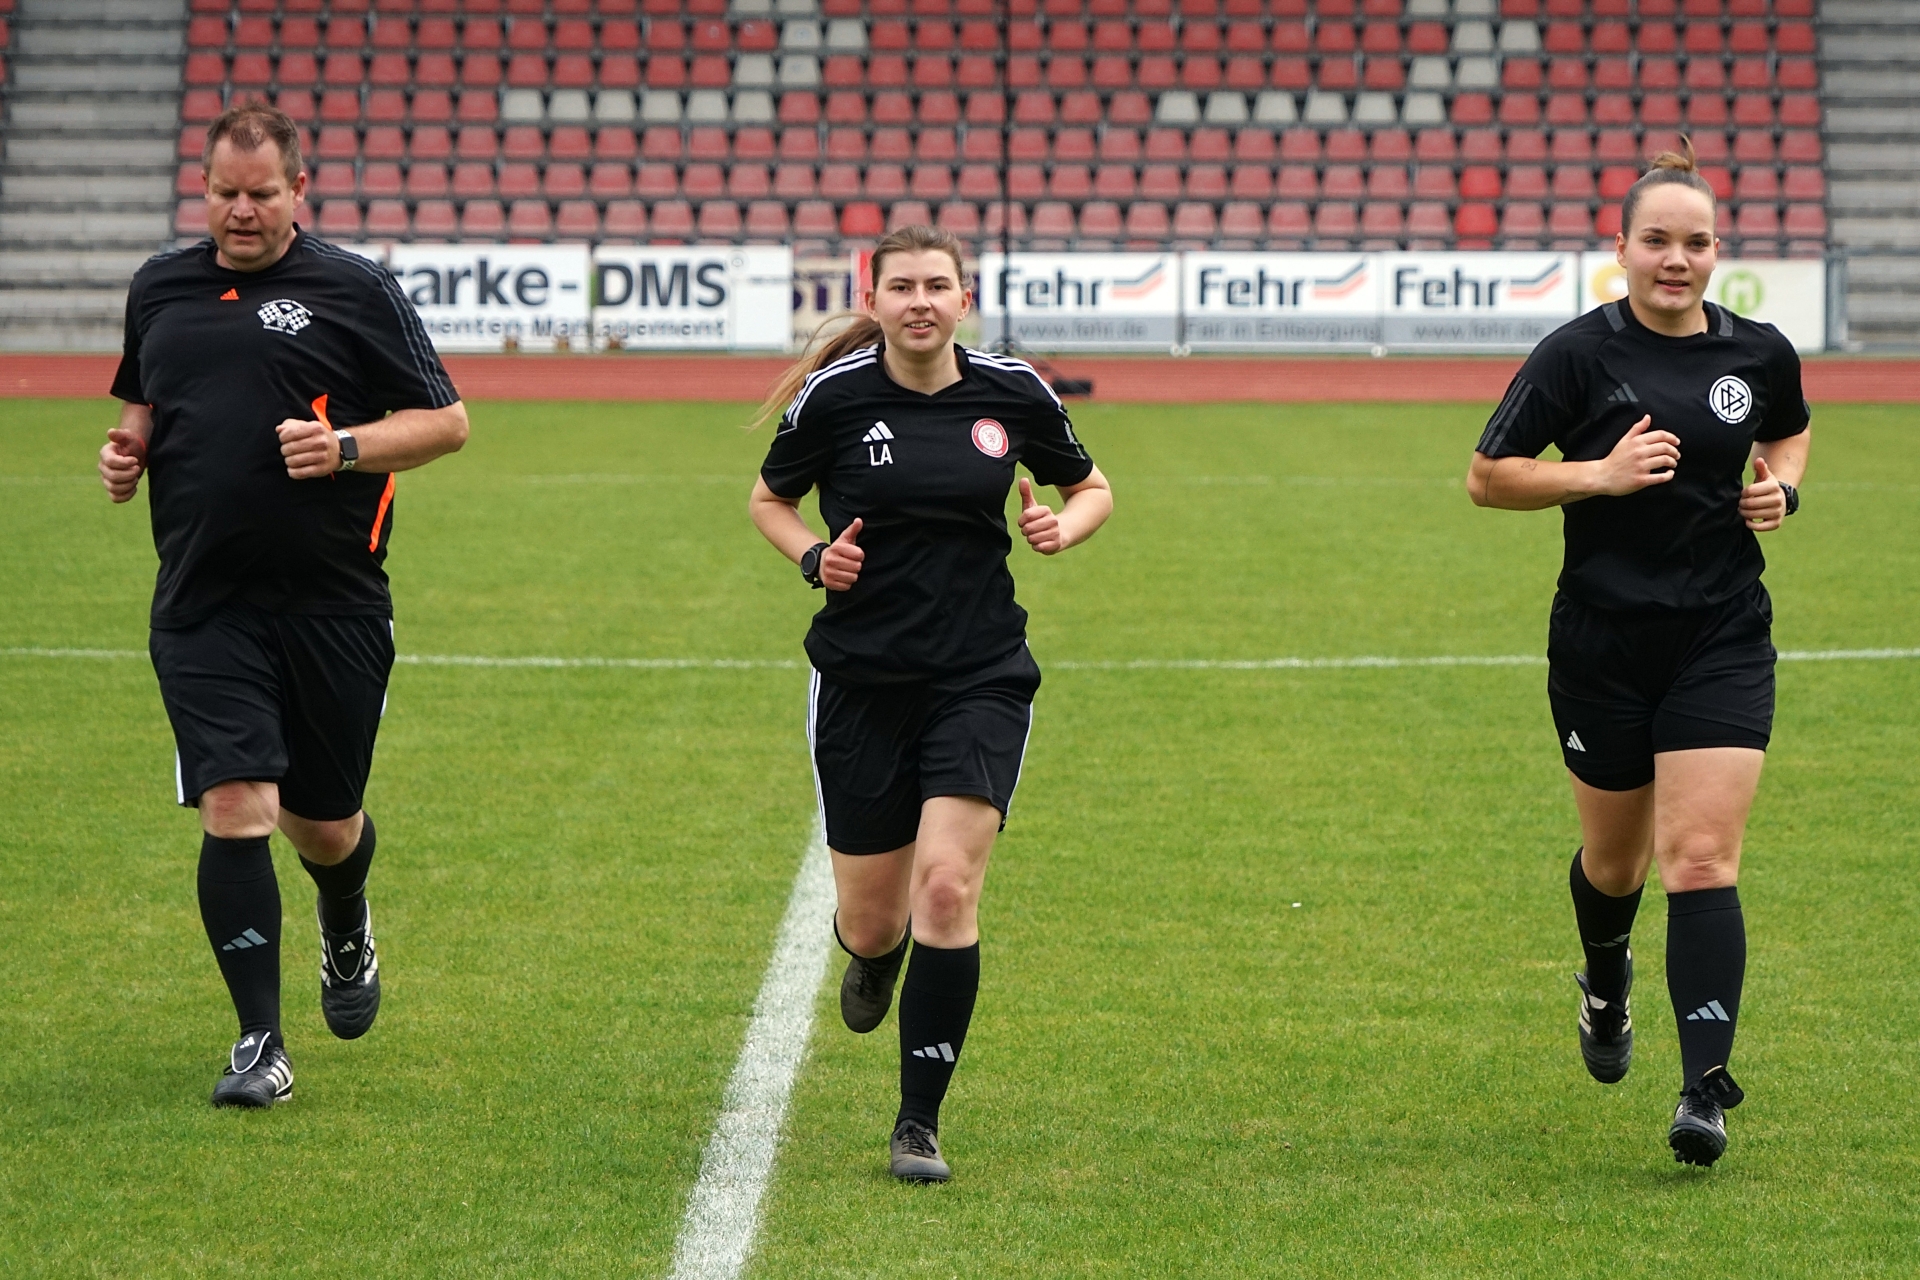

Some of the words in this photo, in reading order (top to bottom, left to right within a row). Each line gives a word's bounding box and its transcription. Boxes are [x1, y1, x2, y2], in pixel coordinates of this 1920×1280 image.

[598, 264, 726, 306] DMS
[999, 269, 1103, 305] Fehr
[1200, 268, 1304, 305] Fehr
[1396, 268, 1500, 306] Fehr
[869, 443, 894, 467] LA
